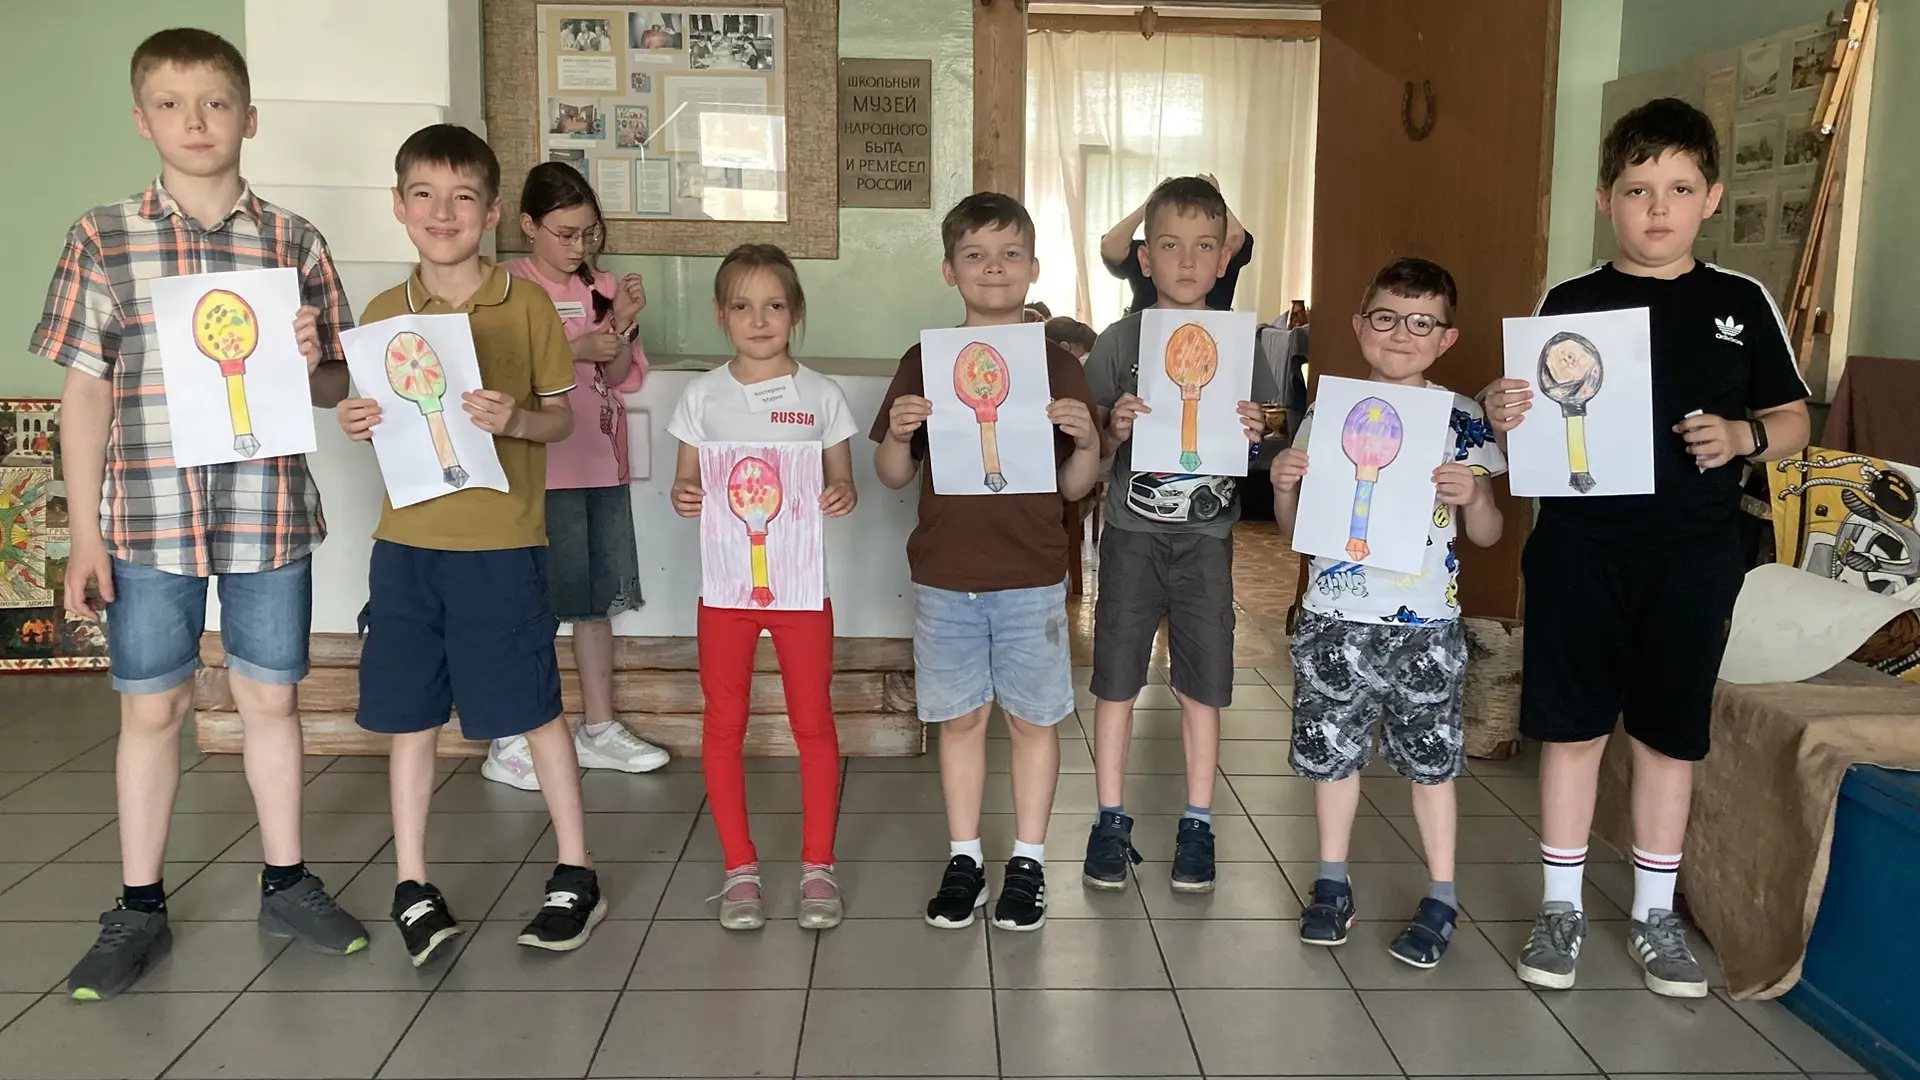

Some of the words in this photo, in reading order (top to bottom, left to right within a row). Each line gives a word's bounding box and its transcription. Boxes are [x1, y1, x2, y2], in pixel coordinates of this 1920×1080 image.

[847, 76, 921, 89] ШКОЛЬНЫЙ
[853, 95, 916, 113] МУЗЕЙ
[844, 122, 928, 136] НАРОДНОГО
[865, 141, 904, 154] БЫТА
[846, 158, 855, 171] И
[859, 159, 926, 173] РЕМЕСЕЛ
[857, 178, 912, 191] РОССИИ
[771, 411, 814, 426] RUSSIA
